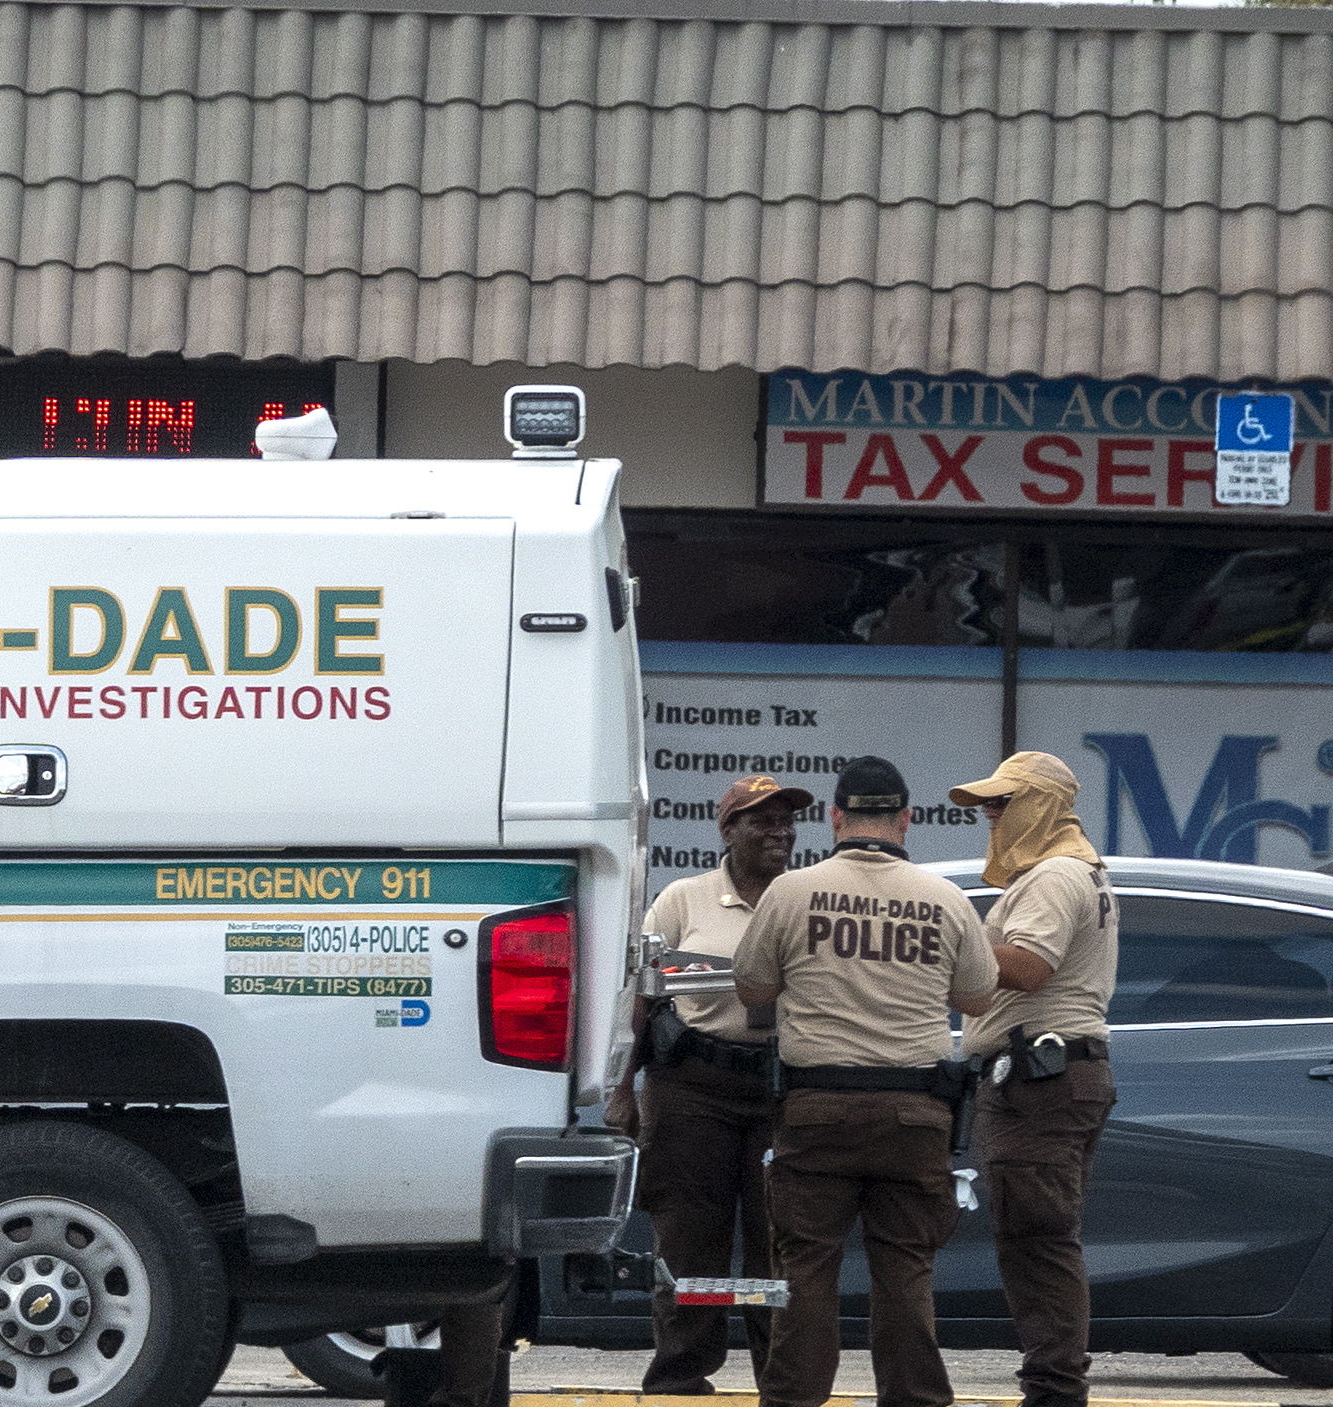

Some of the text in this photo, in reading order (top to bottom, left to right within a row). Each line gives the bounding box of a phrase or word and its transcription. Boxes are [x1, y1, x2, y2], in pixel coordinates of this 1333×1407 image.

[785, 379, 1037, 428] MARTIN
[783, 430, 985, 503] TAX
[1021, 435, 1332, 511] SERI
[655, 702, 818, 727] Income Tax
[653, 748, 849, 774] Corporacione
[155, 866, 431, 899] EMERGENCY 911
[809, 891, 943, 924] MIAMI-DADE
[227, 923, 303, 932] Non-Emergency
[808, 915, 941, 965] POLICE
[226, 955, 432, 976] CRIME STOPPERS
[231, 978, 427, 995] 305-471-TIPS (8477)
